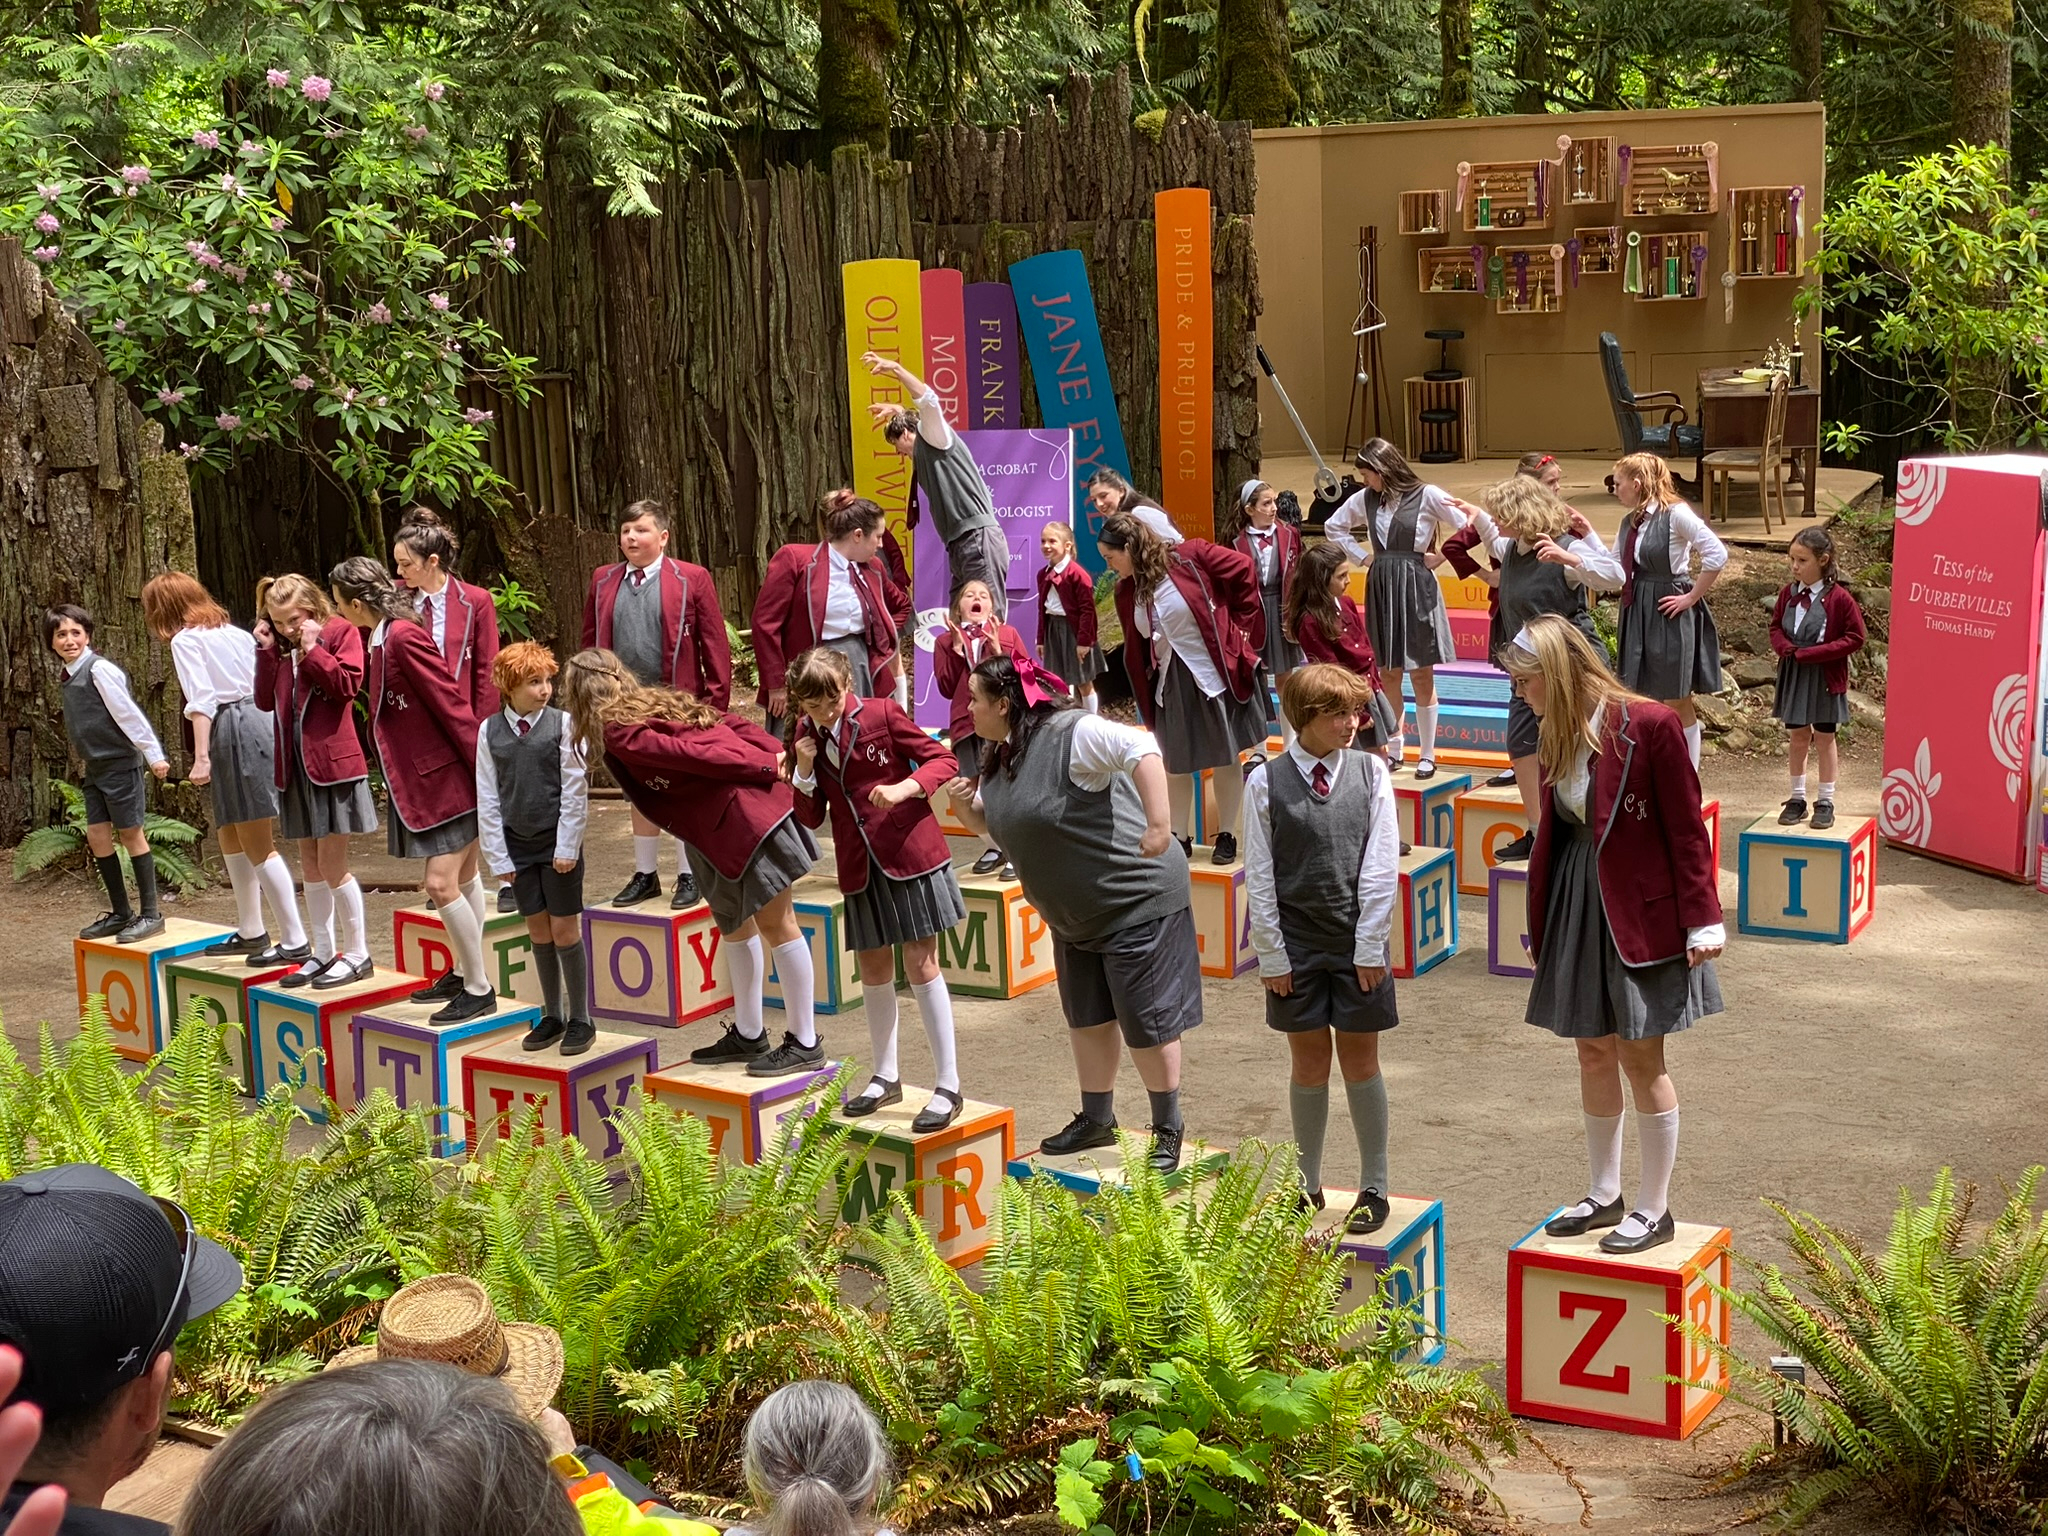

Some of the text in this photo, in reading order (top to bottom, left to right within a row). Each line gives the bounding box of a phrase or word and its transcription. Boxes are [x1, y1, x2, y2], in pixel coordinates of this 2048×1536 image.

[1031, 292, 1093, 406] JANE
[1172, 227, 1197, 481] PRIDE & PREJUDICE
[977, 462, 1038, 476] ACROBAT
[1964, 563, 1978, 585] of
[1976, 566, 1994, 583] the
[1402, 722, 1456, 739] ROEO
[1459, 727, 1471, 740] &
[1417, 876, 1445, 949] H
[1782, 857, 1808, 918] I
[1852, 849, 1865, 914] B
[492, 933, 532, 999] F
[608, 936, 654, 998] O
[687, 925, 721, 993] Y
[937, 910, 991, 973] M
[1018, 904, 1047, 969] P
[100, 969, 141, 1037] Q
[276, 1020, 307, 1089] S
[378, 1045, 421, 1111] T
[587, 1074, 635, 1159] Y
[936, 1152, 987, 1243] R
[1559, 1290, 1630, 1395] Z
[1688, 1281, 1713, 1391] B
